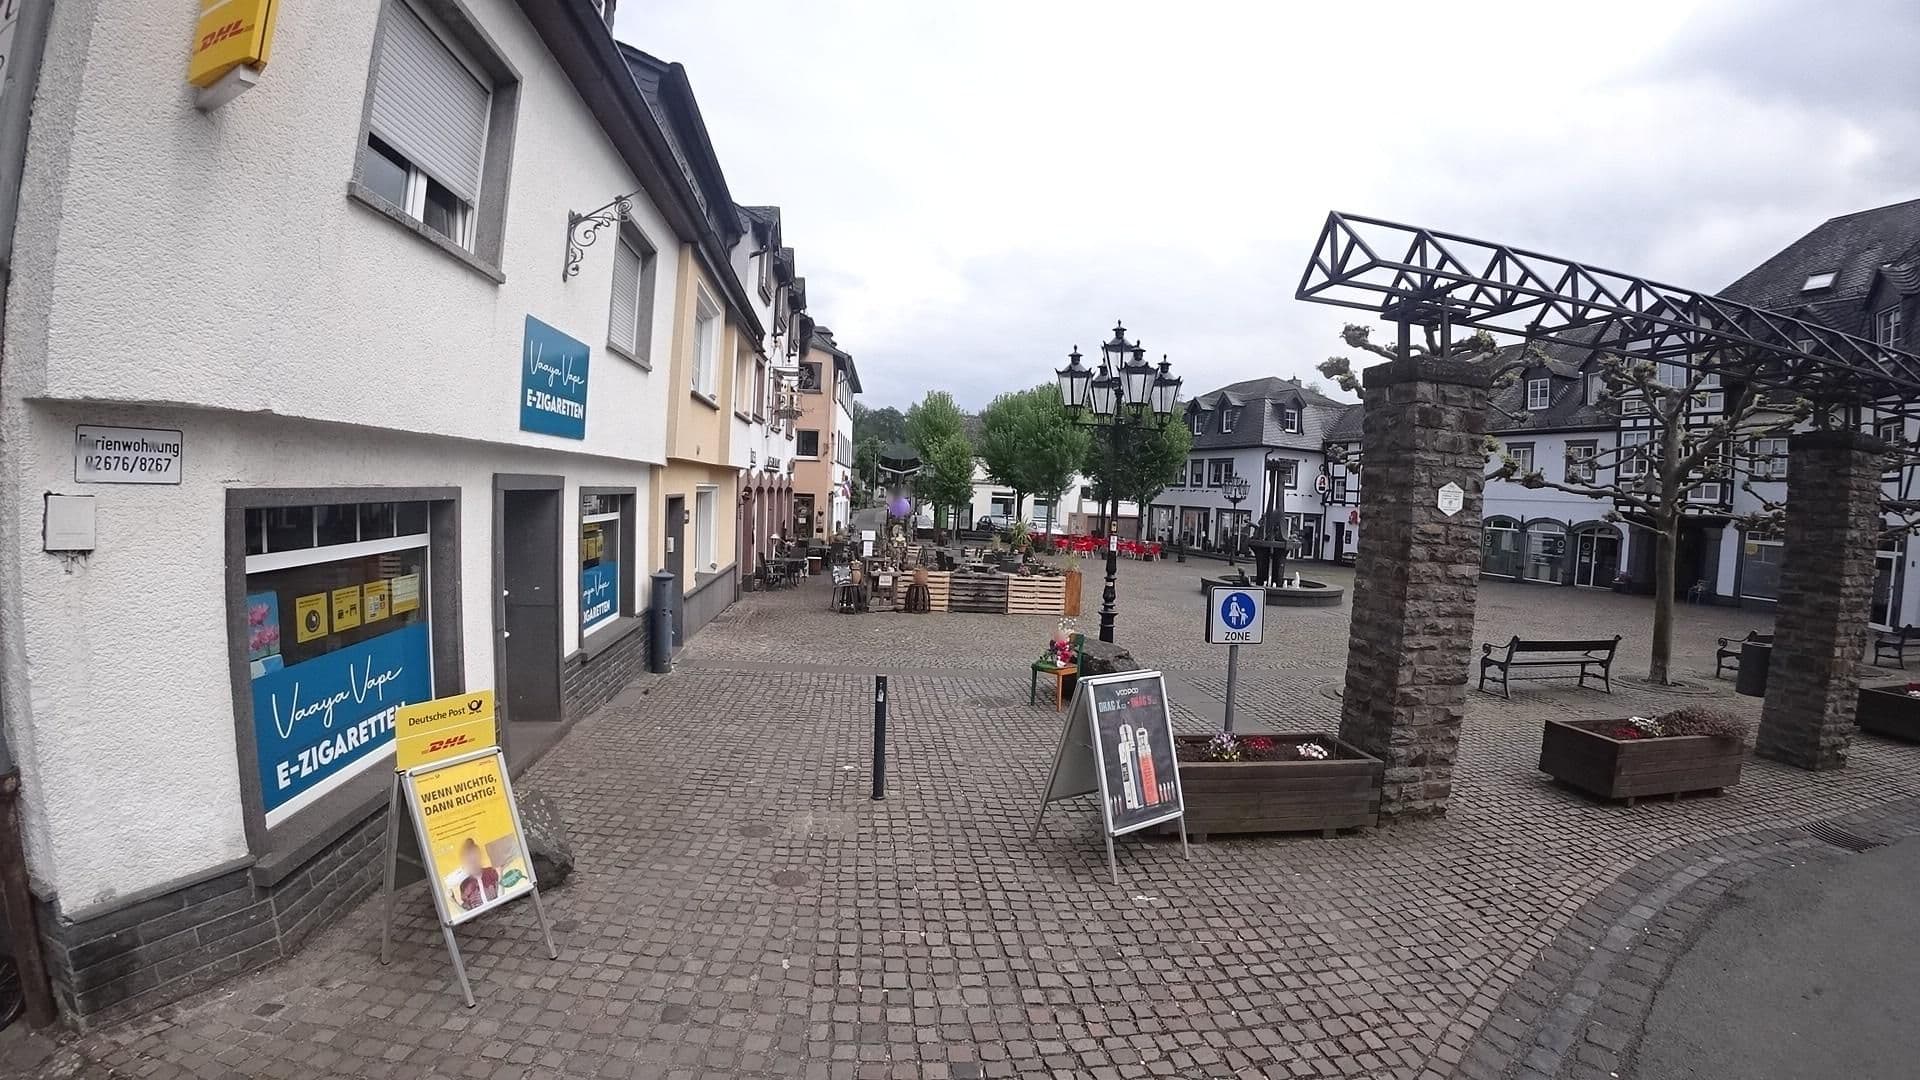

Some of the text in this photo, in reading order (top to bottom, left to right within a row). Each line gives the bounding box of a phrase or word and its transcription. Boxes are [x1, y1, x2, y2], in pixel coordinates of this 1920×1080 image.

[199, 19, 244, 52] DHL
[530, 339, 585, 393] Vaaya Vape
[526, 388, 585, 420] E-ZIGARETTEN
[1224, 631, 1251, 641] ZONE
[271, 655, 403, 739] Vaaya Vape
[408, 707, 466, 727] Deutsche Post
[429, 734, 468, 753] DHL
[420, 786, 453, 804] WENN
[453, 774, 497, 794] WICHTIG,
[424, 786, 497, 816] DANN RICHTIG!
